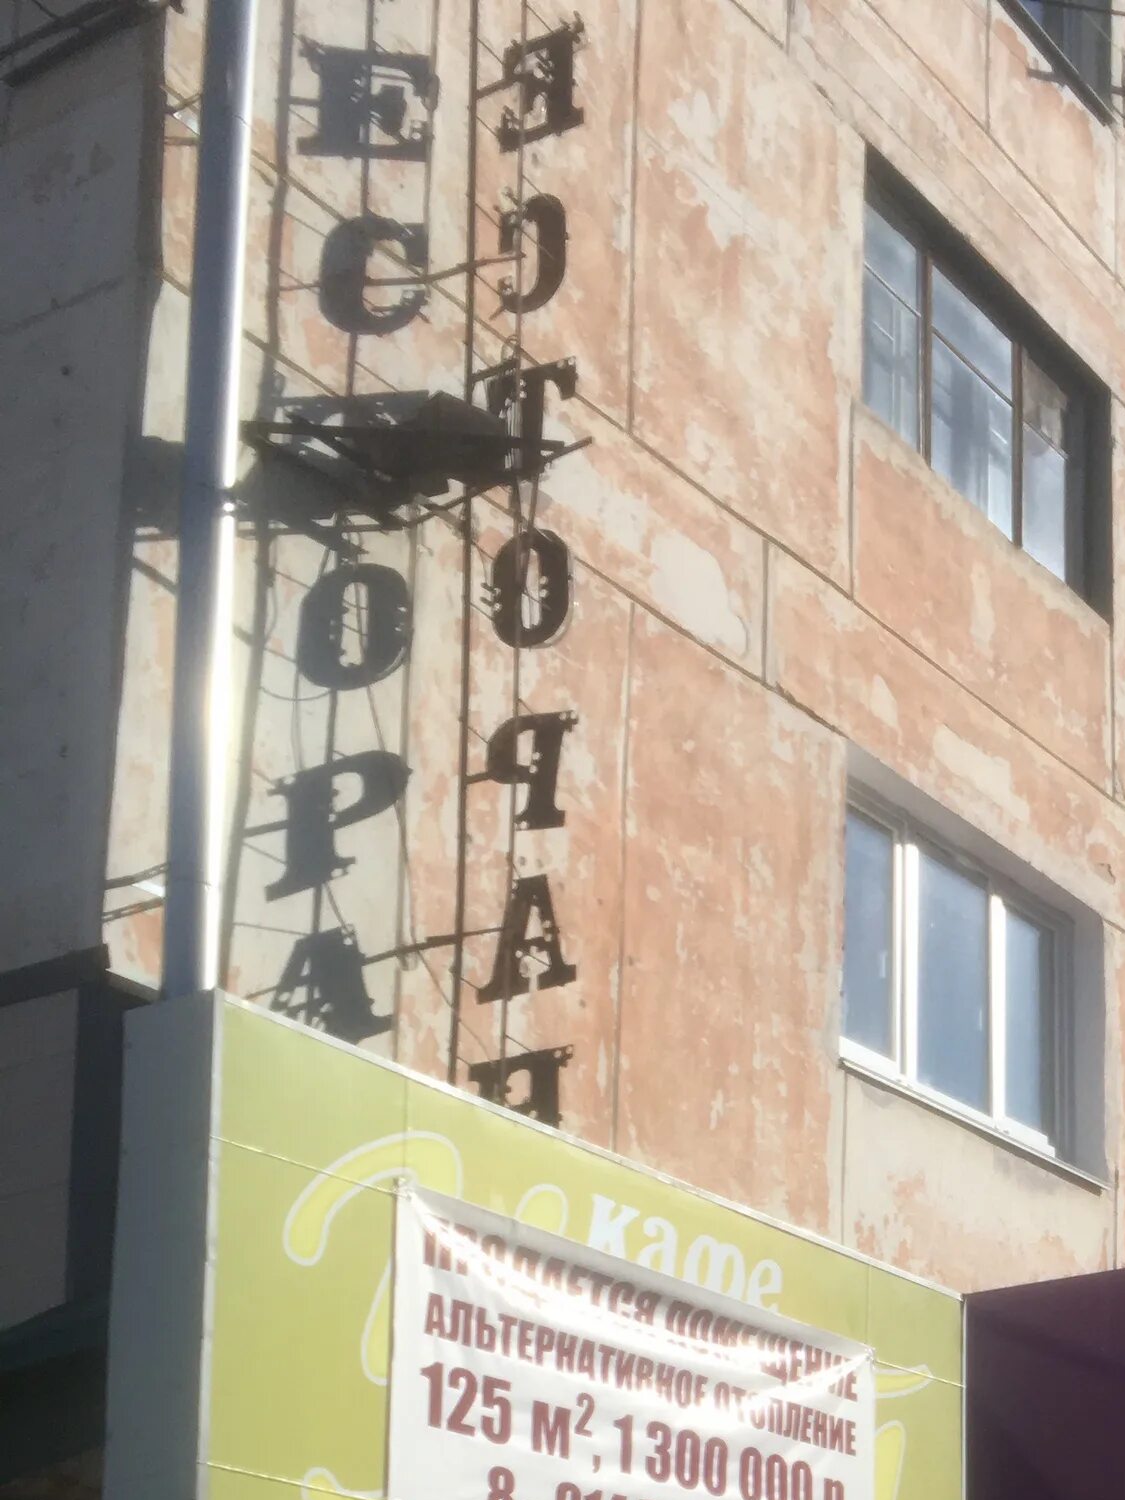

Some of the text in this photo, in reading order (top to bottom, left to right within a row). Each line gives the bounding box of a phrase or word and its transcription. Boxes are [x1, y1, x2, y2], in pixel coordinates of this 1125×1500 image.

[424, 1292, 709, 1409] АЛЬТЕРНАТИВНОЕ
[420, 1361, 512, 1445] 125
[645, 1421, 728, 1497] 300
